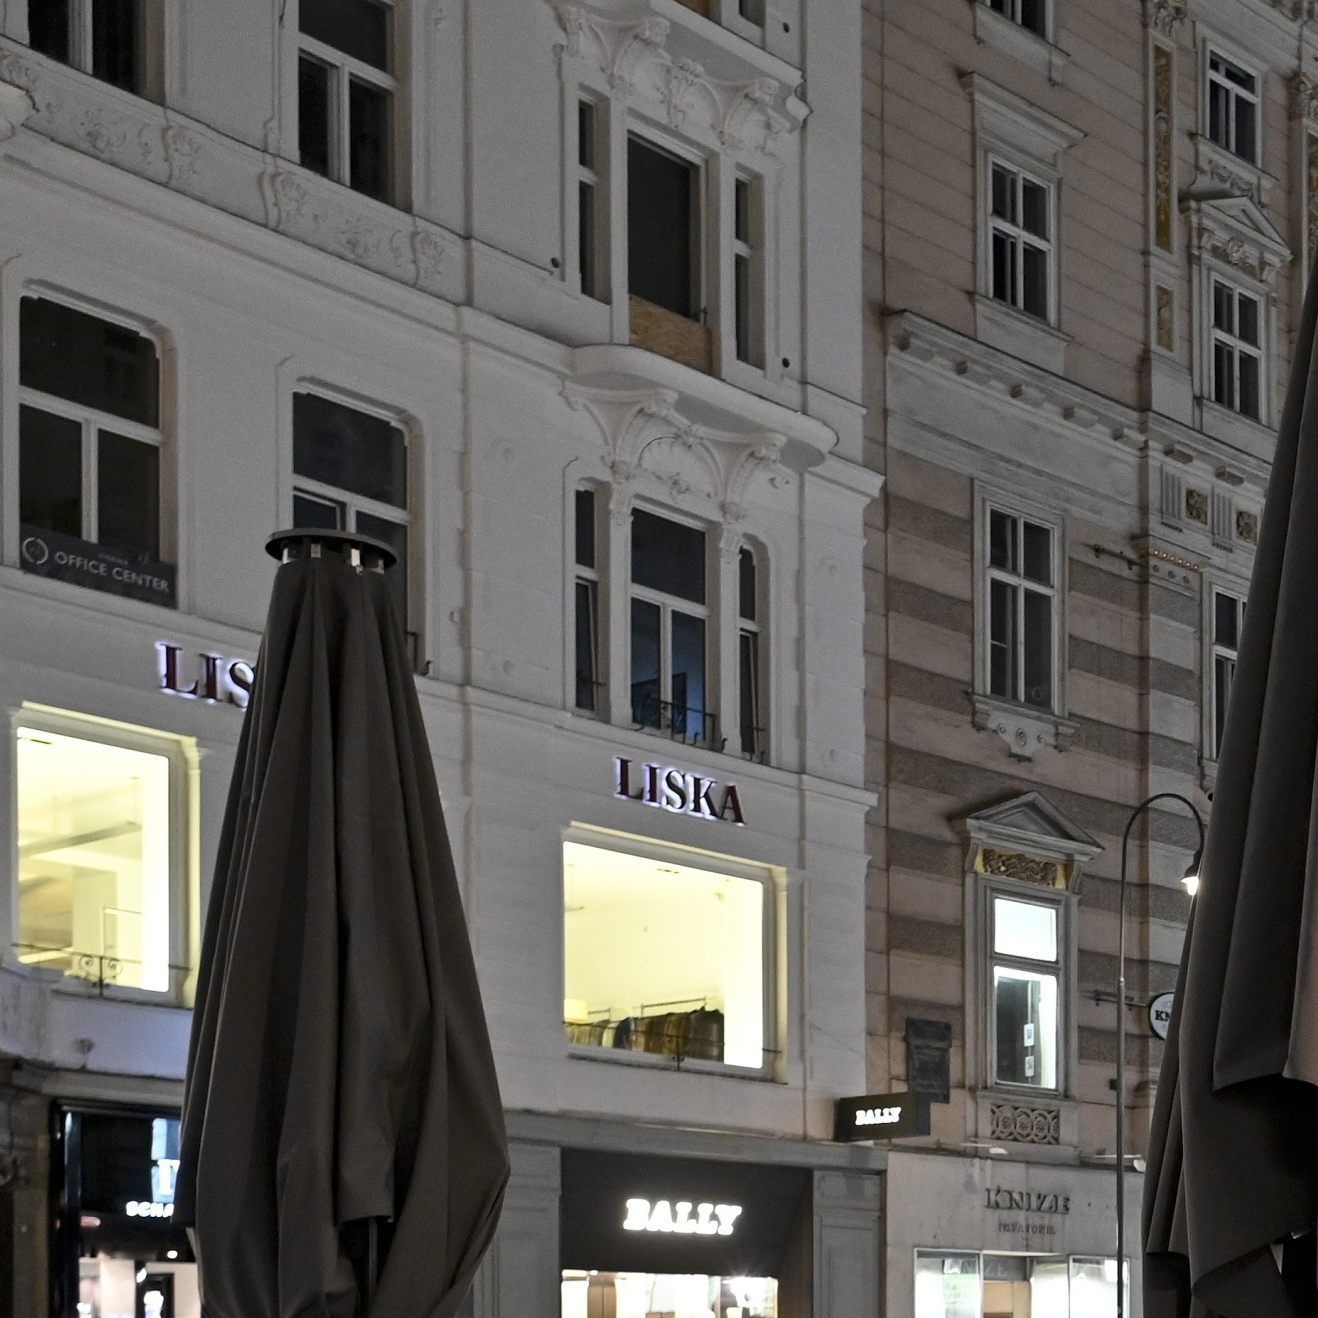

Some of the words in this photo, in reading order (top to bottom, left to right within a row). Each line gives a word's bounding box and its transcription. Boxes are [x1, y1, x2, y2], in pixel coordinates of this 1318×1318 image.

[54, 551, 108, 577] OFFICE
[111, 566, 170, 593] CENTER
[614, 755, 747, 826] LISKA
[855, 1106, 902, 1126] BALLY
[622, 1198, 743, 1236] BALLY
[985, 1185, 1070, 1214] KNIZE
